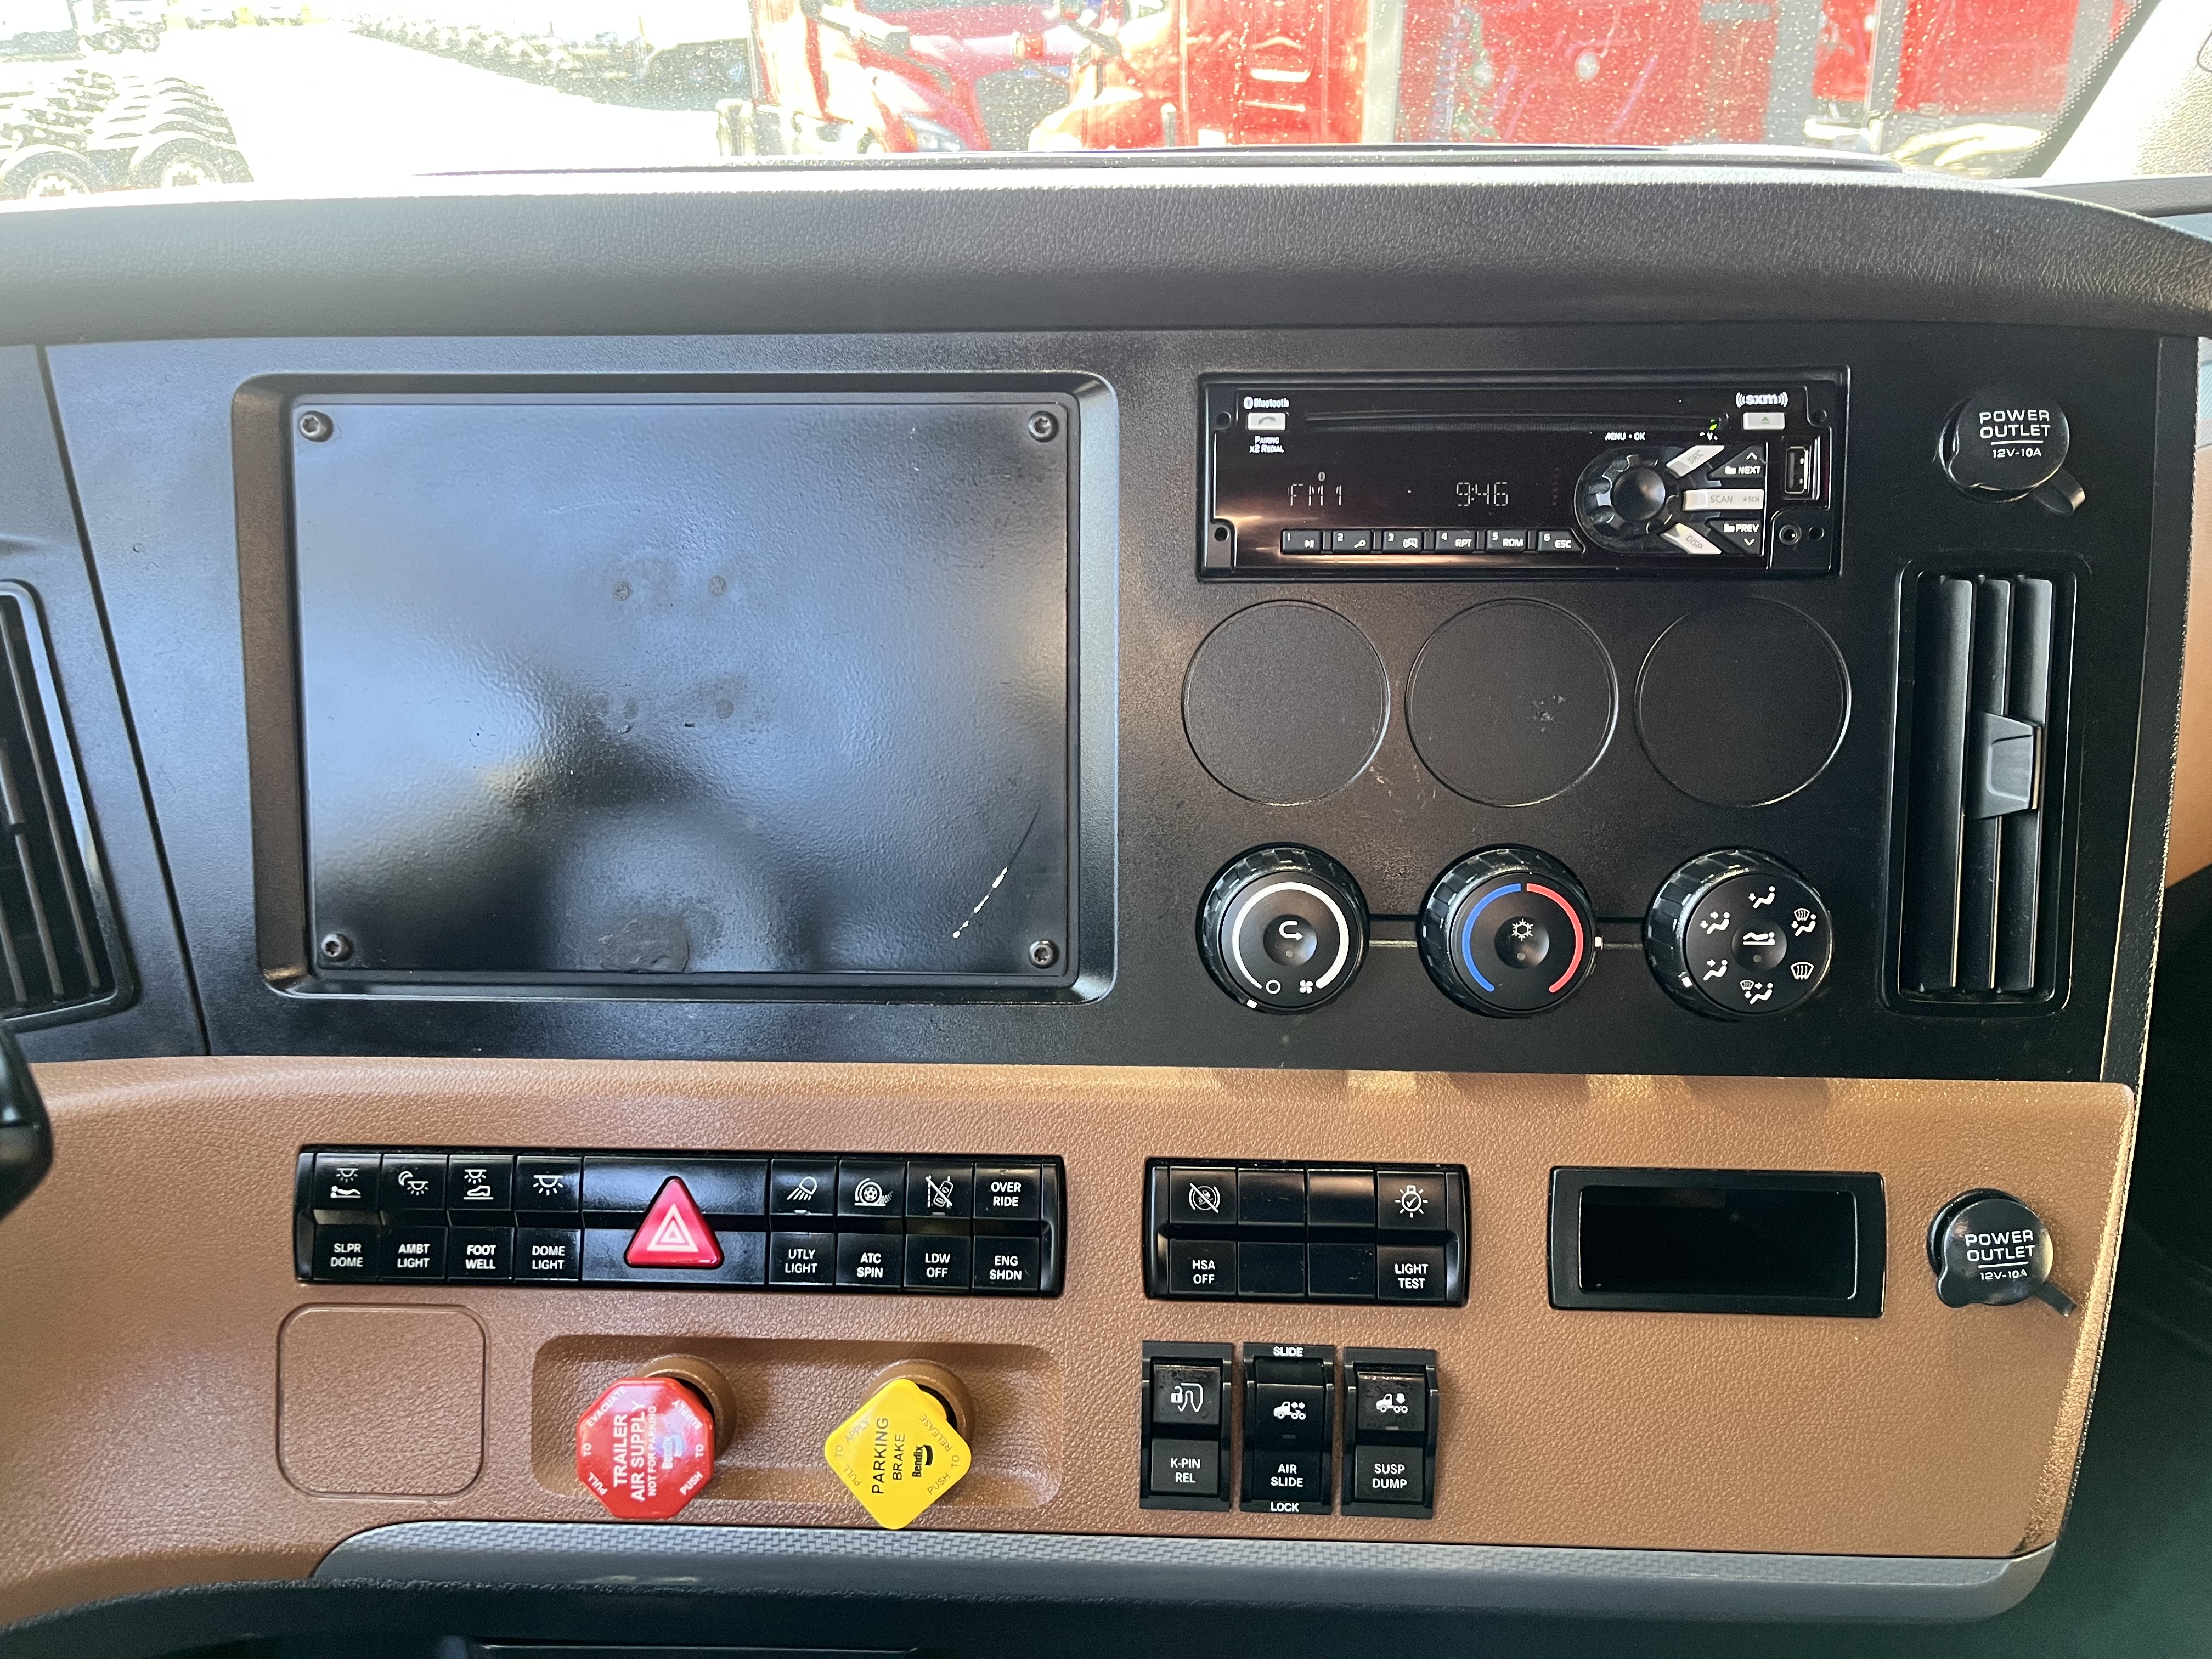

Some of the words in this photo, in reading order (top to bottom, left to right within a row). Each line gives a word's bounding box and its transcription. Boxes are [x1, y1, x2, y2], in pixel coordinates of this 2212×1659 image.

[1254, 398, 1289, 408] Bluetooth
[1979, 409, 2050, 424] POWER
[1634, 432, 1646, 441] OK
[1979, 424, 2051, 439] OUTLET
[1688, 449, 1703, 464] SRC
[1992, 448, 2042, 458] 12V-10A
[1738, 466, 1761, 475] NEXT
[1456, 482, 1508, 507] 9:46
[1735, 523, 1759, 533] PREV
[1337, 533, 1344, 541] 2
[1387, 533, 1394, 541] 3
[1440, 532, 1448, 541] 4
[1492, 532, 1498, 540] 5
[1543, 532, 1551, 541] 6
[1455, 538, 1472, 548] RPT
[1502, 538, 1523, 548] RDM
[1555, 539, 1572, 549] ESC
[1685, 535, 1703, 549] DISP
[991, 1181, 1022, 1193] OVER
[992, 1195, 1019, 1207] RIDE
[1965, 1229, 2034, 1246] POWER
[334, 1243, 362, 1254] SLPR
[398, 1244, 430, 1254] AMBT
[467, 1245, 496, 1256] FOOT
[532, 1245, 565, 1256] DOME
[1967, 1245, 2035, 1262] OUTLET
[788, 1249, 816, 1260] UTLY
[860, 1252, 881, 1263] ATC
[925, 1253, 950, 1264] LDW
[330, 1257, 363, 1267] DOME
[397, 1257, 430, 1268] LIGHT
[466, 1259, 496, 1269] WELL
[532, 1260, 565, 1270] LIGHT
[995, 1256, 1018, 1267] ENG
[1192, 1260, 1216, 1271] HSA
[785, 1263, 817, 1274] LIGHT
[857, 1266, 883, 1278] SPIN
[926, 1267, 949, 1278] OFF
[1395, 1263, 1429, 1275] LIGHT
[989, 1269, 1022, 1281] SHDN
[1193, 1274, 1215, 1284] OFF
[1980, 1269, 2028, 1280] 12V-10A
[1398, 1278, 1426, 1289] TEST
[1273, 1346, 1304, 1357] SLIDE
[586, 1386, 628, 1427] EVACUATE
[672, 1400, 703, 1430] SUPPLY
[631, 1401, 645, 1468] SUPPLY
[648, 1406, 657, 1452] PARKING
[845, 1418, 870, 1443] APPLY
[919, 1413, 952, 1451] RELEASE
[583, 1444, 591, 1457] TO
[613, 1415, 628, 1487] TRAILER
[695, 1444, 704, 1458] TO
[835, 1446, 843, 1458] TO
[872, 1418, 889, 1493] PARKING
[893, 1435, 905, 1480] BRAKE
[912, 1446, 922, 1477] Bendix
[951, 1455, 960, 1468] TO
[648, 1455, 657, 1474] FOR
[1171, 1458, 1200, 1469] K-PIN
[1278, 1464, 1297, 1475] AIR
[1374, 1464, 1406, 1475] SUSP
[843, 1465, 862, 1486] PULL
[1175, 1472, 1196, 1483] REL
[588, 1472, 608, 1495] PULL
[631, 1474, 645, 1501] AIR
[648, 1476, 657, 1496] NOT
[680, 1472, 703, 1495] PUSH
[927, 1473, 950, 1494] PUSH
[1271, 1477, 1304, 1487] SLIDE
[1372, 1479, 1408, 1489] DUMP
[1270, 1502, 1300, 1513] LOCK
